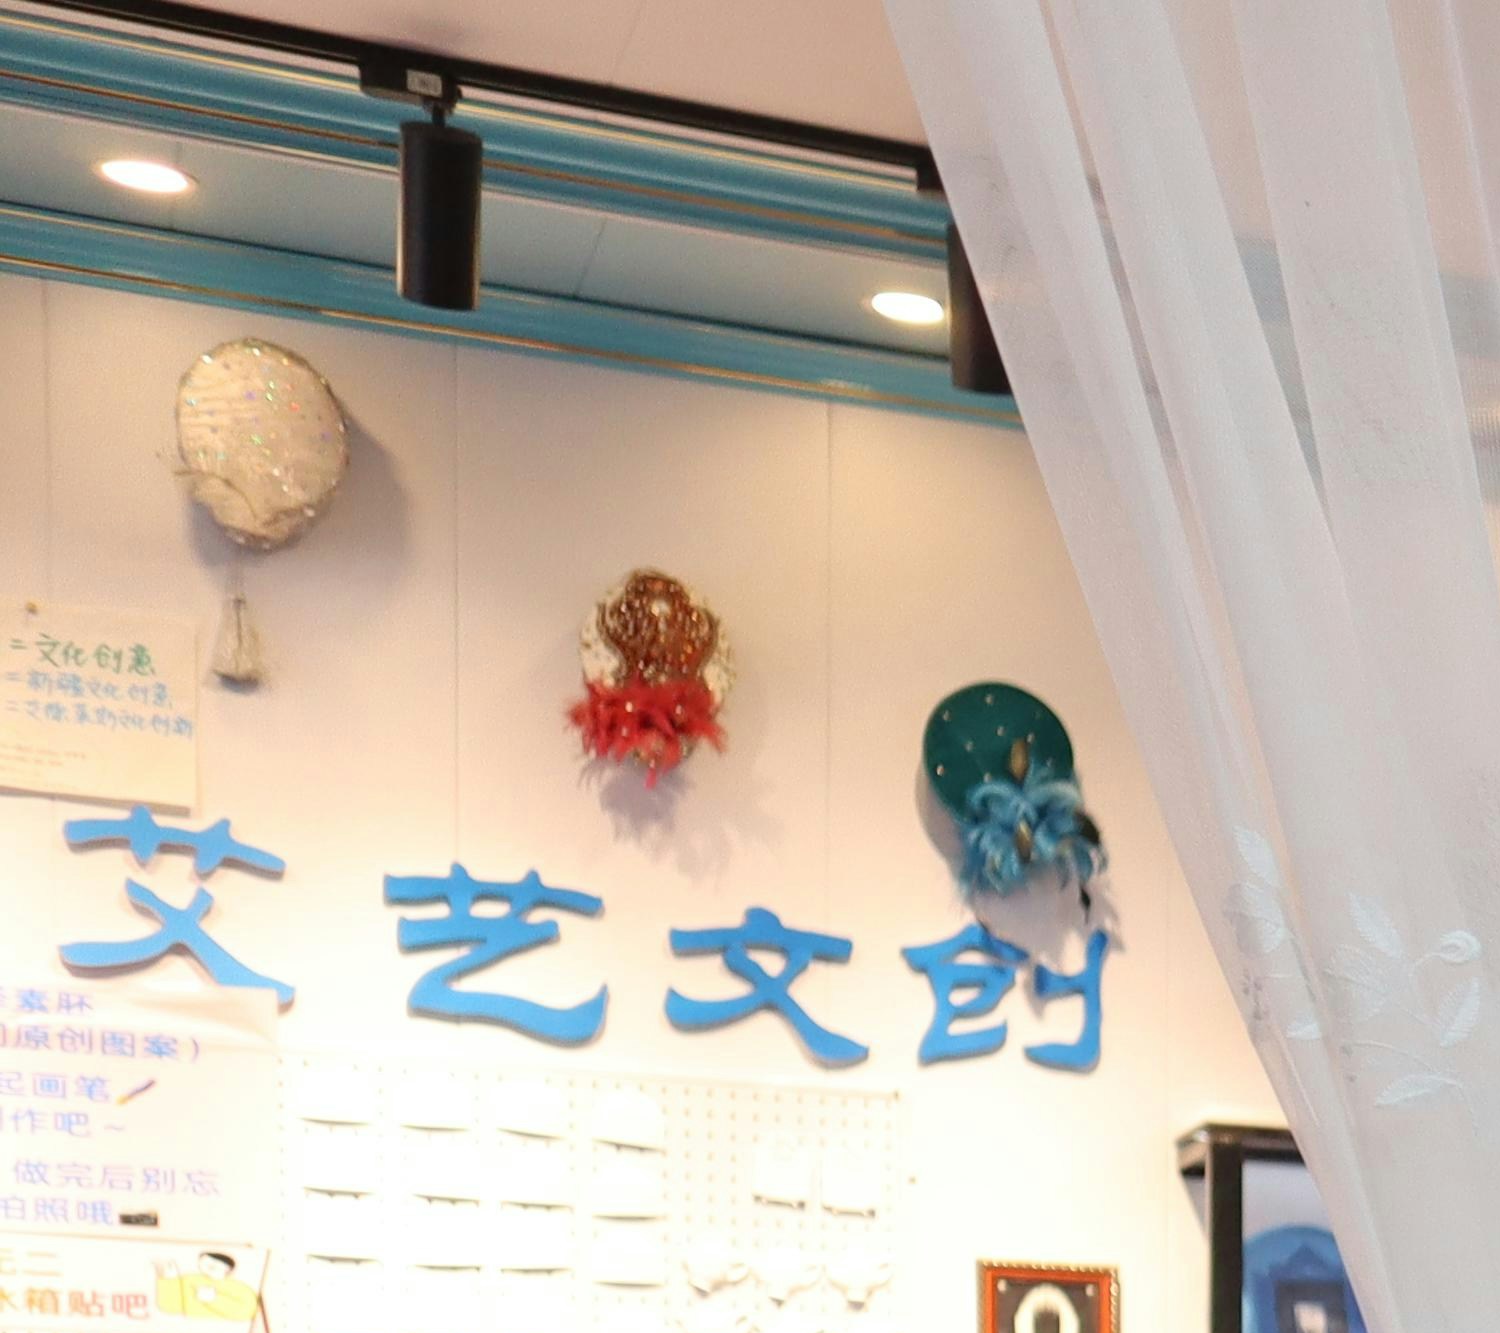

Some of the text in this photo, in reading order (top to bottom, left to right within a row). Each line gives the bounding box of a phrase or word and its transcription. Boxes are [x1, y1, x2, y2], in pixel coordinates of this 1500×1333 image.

[0, 986, 94, 1013] 素胚
[58, 803, 1108, 1072] 艾艺文创
